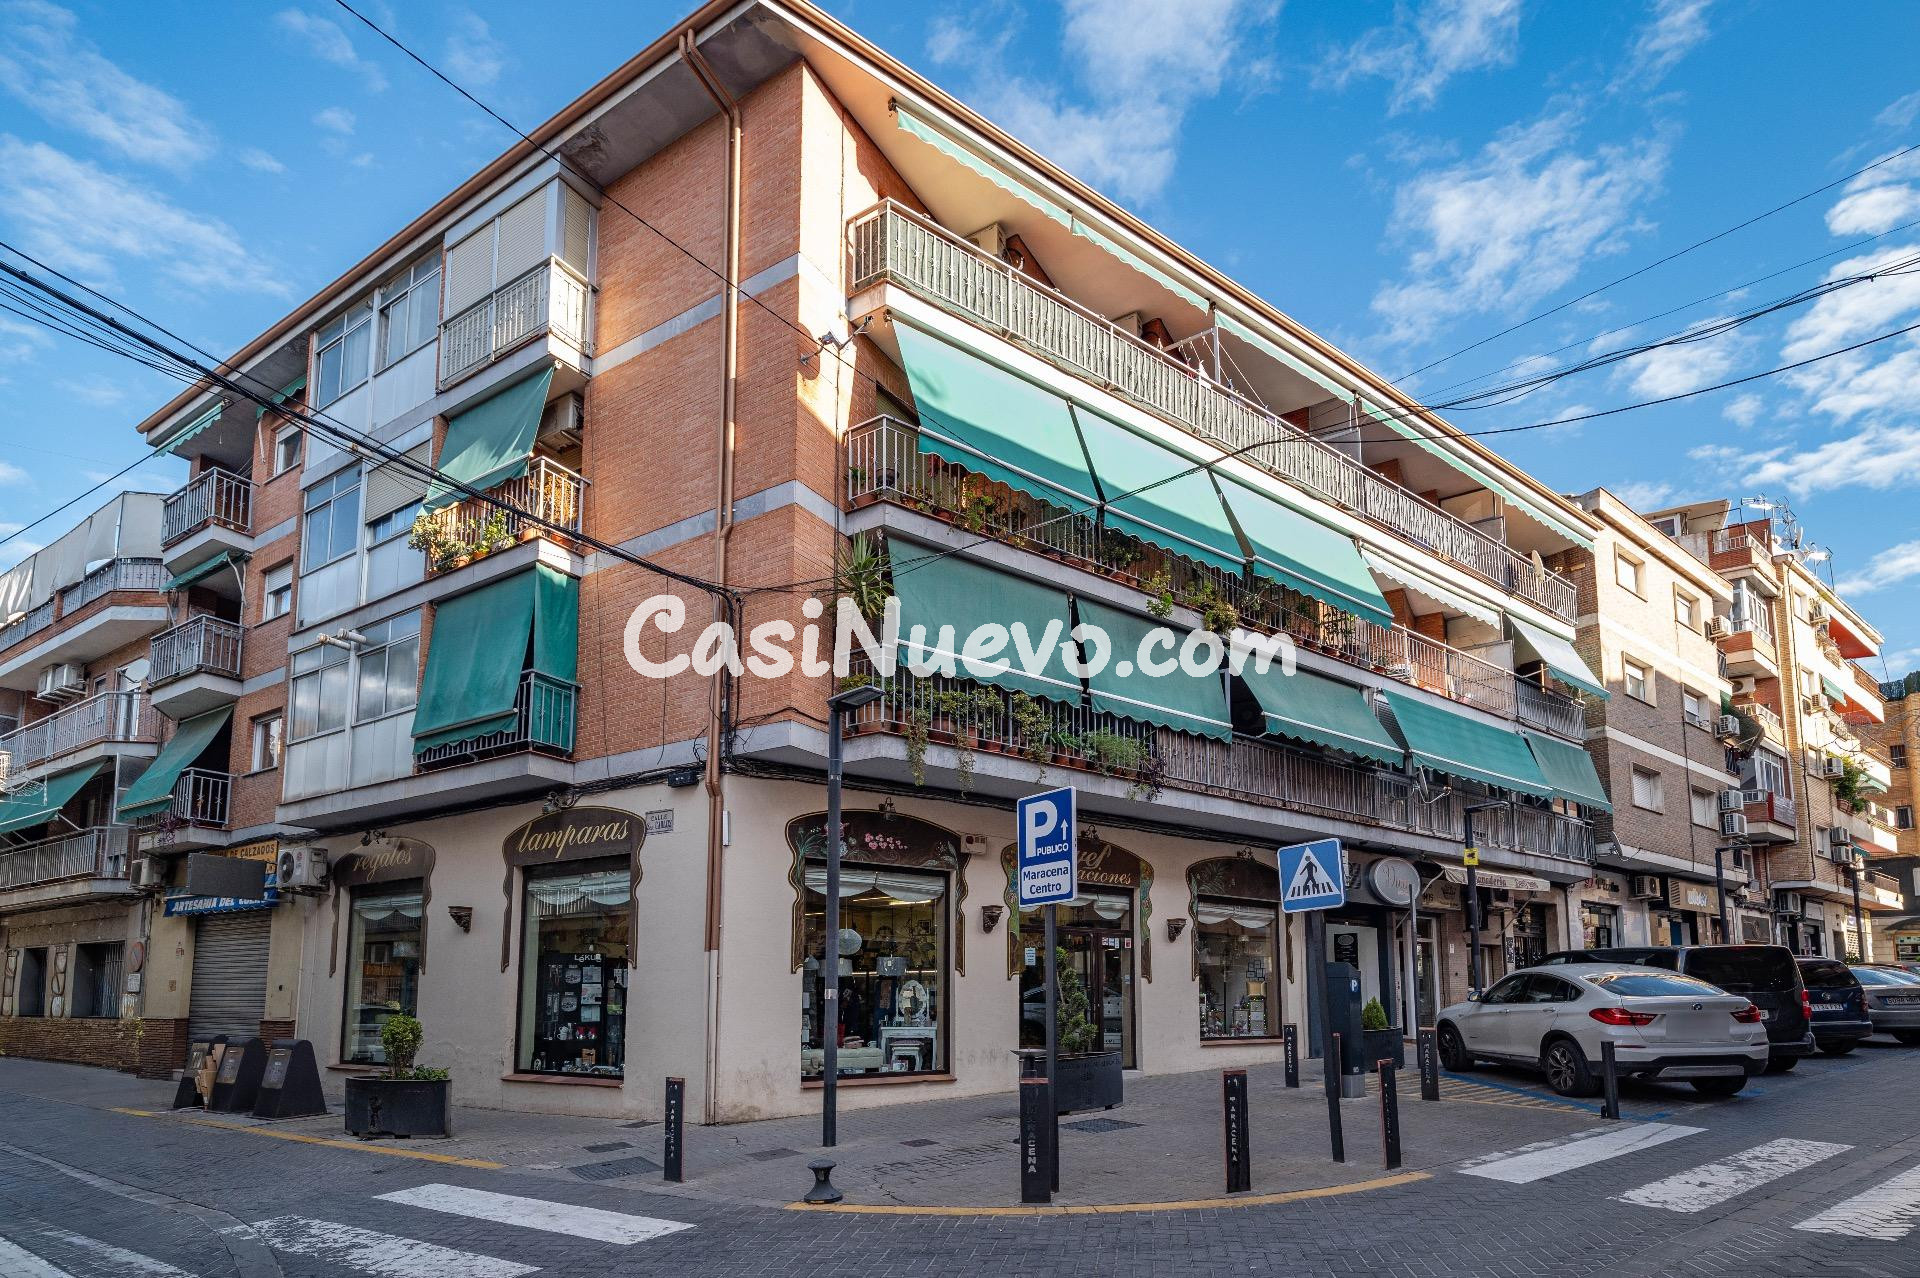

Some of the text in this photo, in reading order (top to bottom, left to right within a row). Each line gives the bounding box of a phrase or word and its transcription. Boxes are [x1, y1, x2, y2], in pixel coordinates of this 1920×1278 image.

[1026, 800, 1058, 859] P
[240, 843, 275, 858] CALZADOS
[1036, 843, 1069, 857] PUBLICO
[353, 845, 412, 881] regalos
[1023, 865, 1069, 881] Maracena
[1077, 868, 1131, 885] aciones
[1029, 881, 1062, 895] Centro
[172, 897, 218, 911] ARTESANIA
[1229, 1096, 1238, 1162] MARACENA
